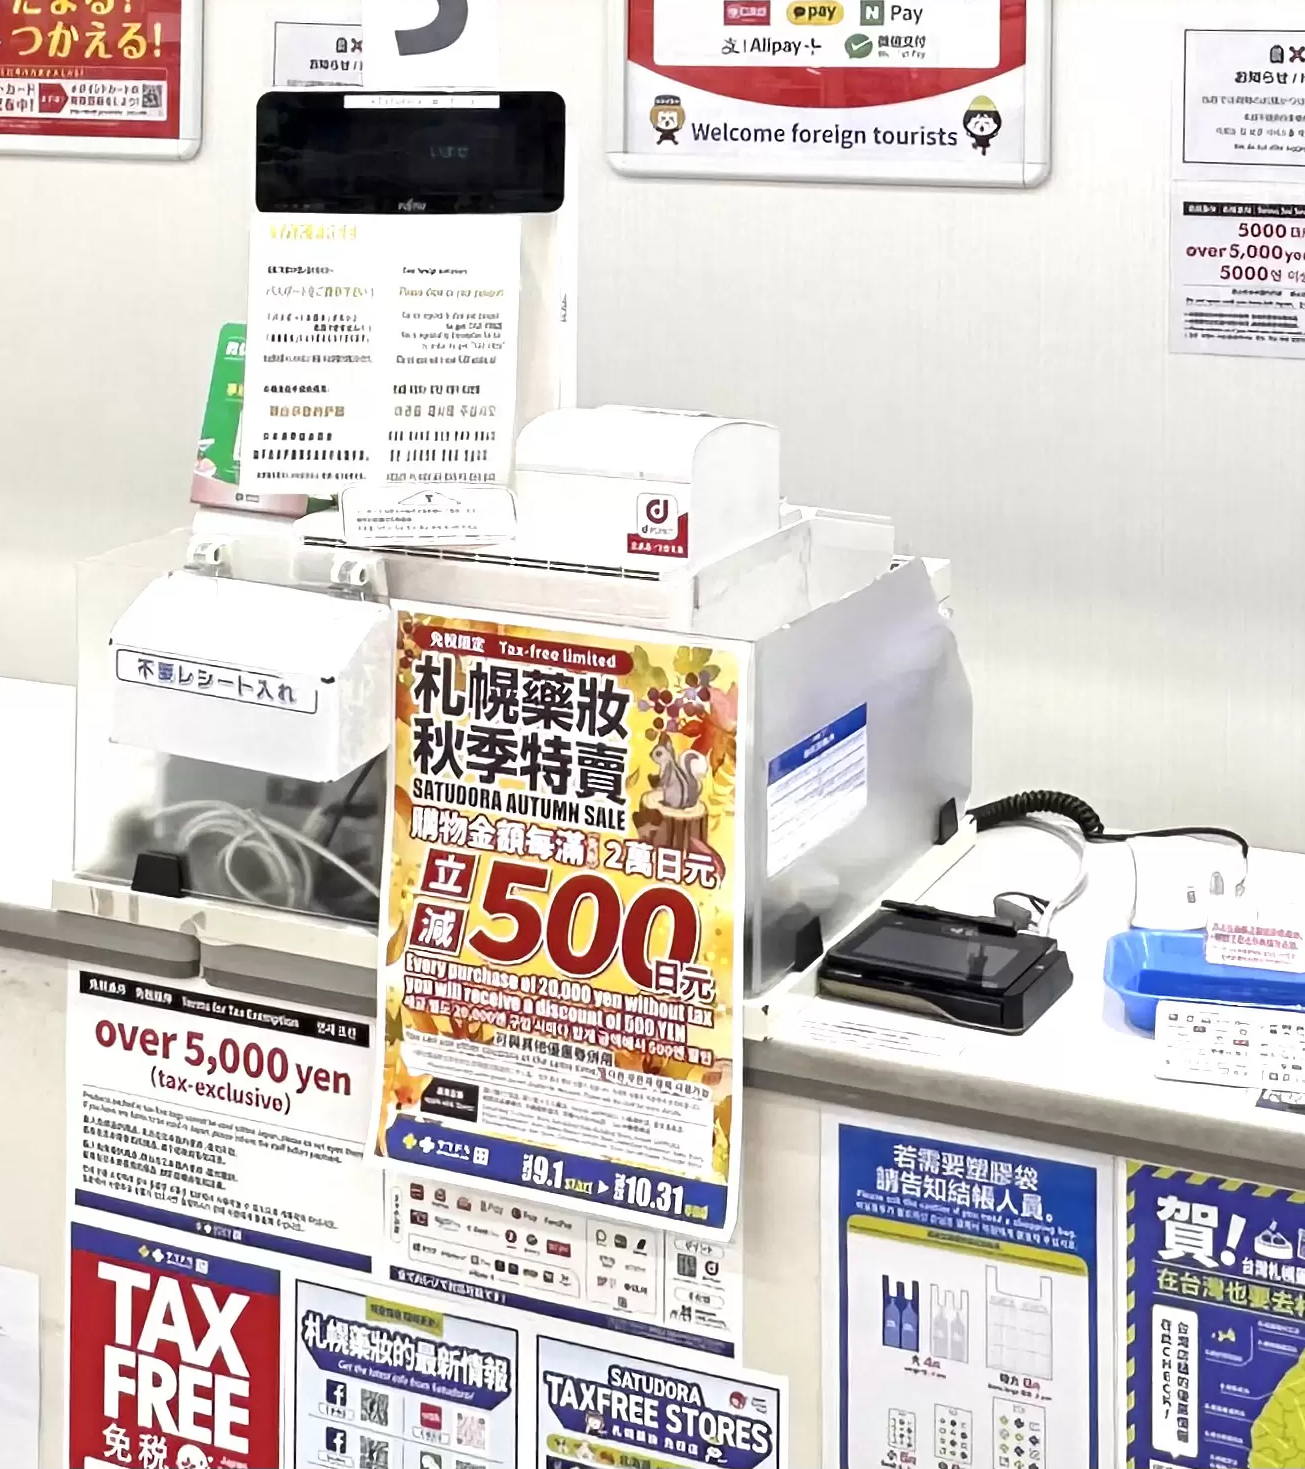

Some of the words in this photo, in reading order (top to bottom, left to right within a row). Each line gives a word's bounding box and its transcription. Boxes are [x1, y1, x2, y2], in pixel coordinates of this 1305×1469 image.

[12, 22, 162, 59] つかえる！
[891, 5, 923, 26] Pay
[691, 123, 784, 144] Welcome
[792, 123, 867, 149] foreign
[874, 125, 958, 147] tourists
[1186, 246, 1226, 258] over
[1230, 246, 1283, 260] 5,000
[1239, 224, 1286, 238] 5000
[499, 641, 560, 662] Tax-free
[563, 650, 617, 669] limited
[414, 655, 631, 740] 札幌藥妝
[413, 717, 628, 806] 秋季特賣
[413, 778, 502, 811] SATUDORA
[506, 793, 579, 824] AUTUMN
[585, 807, 626, 831] SALE
[469, 860, 698, 990] 500
[406, 955, 446, 979] Every
[449, 963, 518, 992] purchase
[594, 991, 622, 1010] yen
[624, 993, 685, 1020] without
[406, 977, 433, 996] you
[435, 980, 462, 998] will
[535, 998, 603, 1027] discount
[655, 961, 715, 1001] 日元
[95, 1019, 177, 1059] over
[184, 1031, 289, 1083] 5,000
[295, 1062, 352, 1096] yen
[150, 1065, 291, 1115] (tax-exclusive)
[625, 1175, 684, 1215] 10.31
[1157, 1195, 1247, 1269] 賀！
[97, 1261, 250, 1378] TAX
[104, 1345, 249, 1454] FREE
[610, 1367, 701, 1406] SATUDORA
[545, 1374, 659, 1428] TAXFREE
[666, 1404, 770, 1454] STORES
